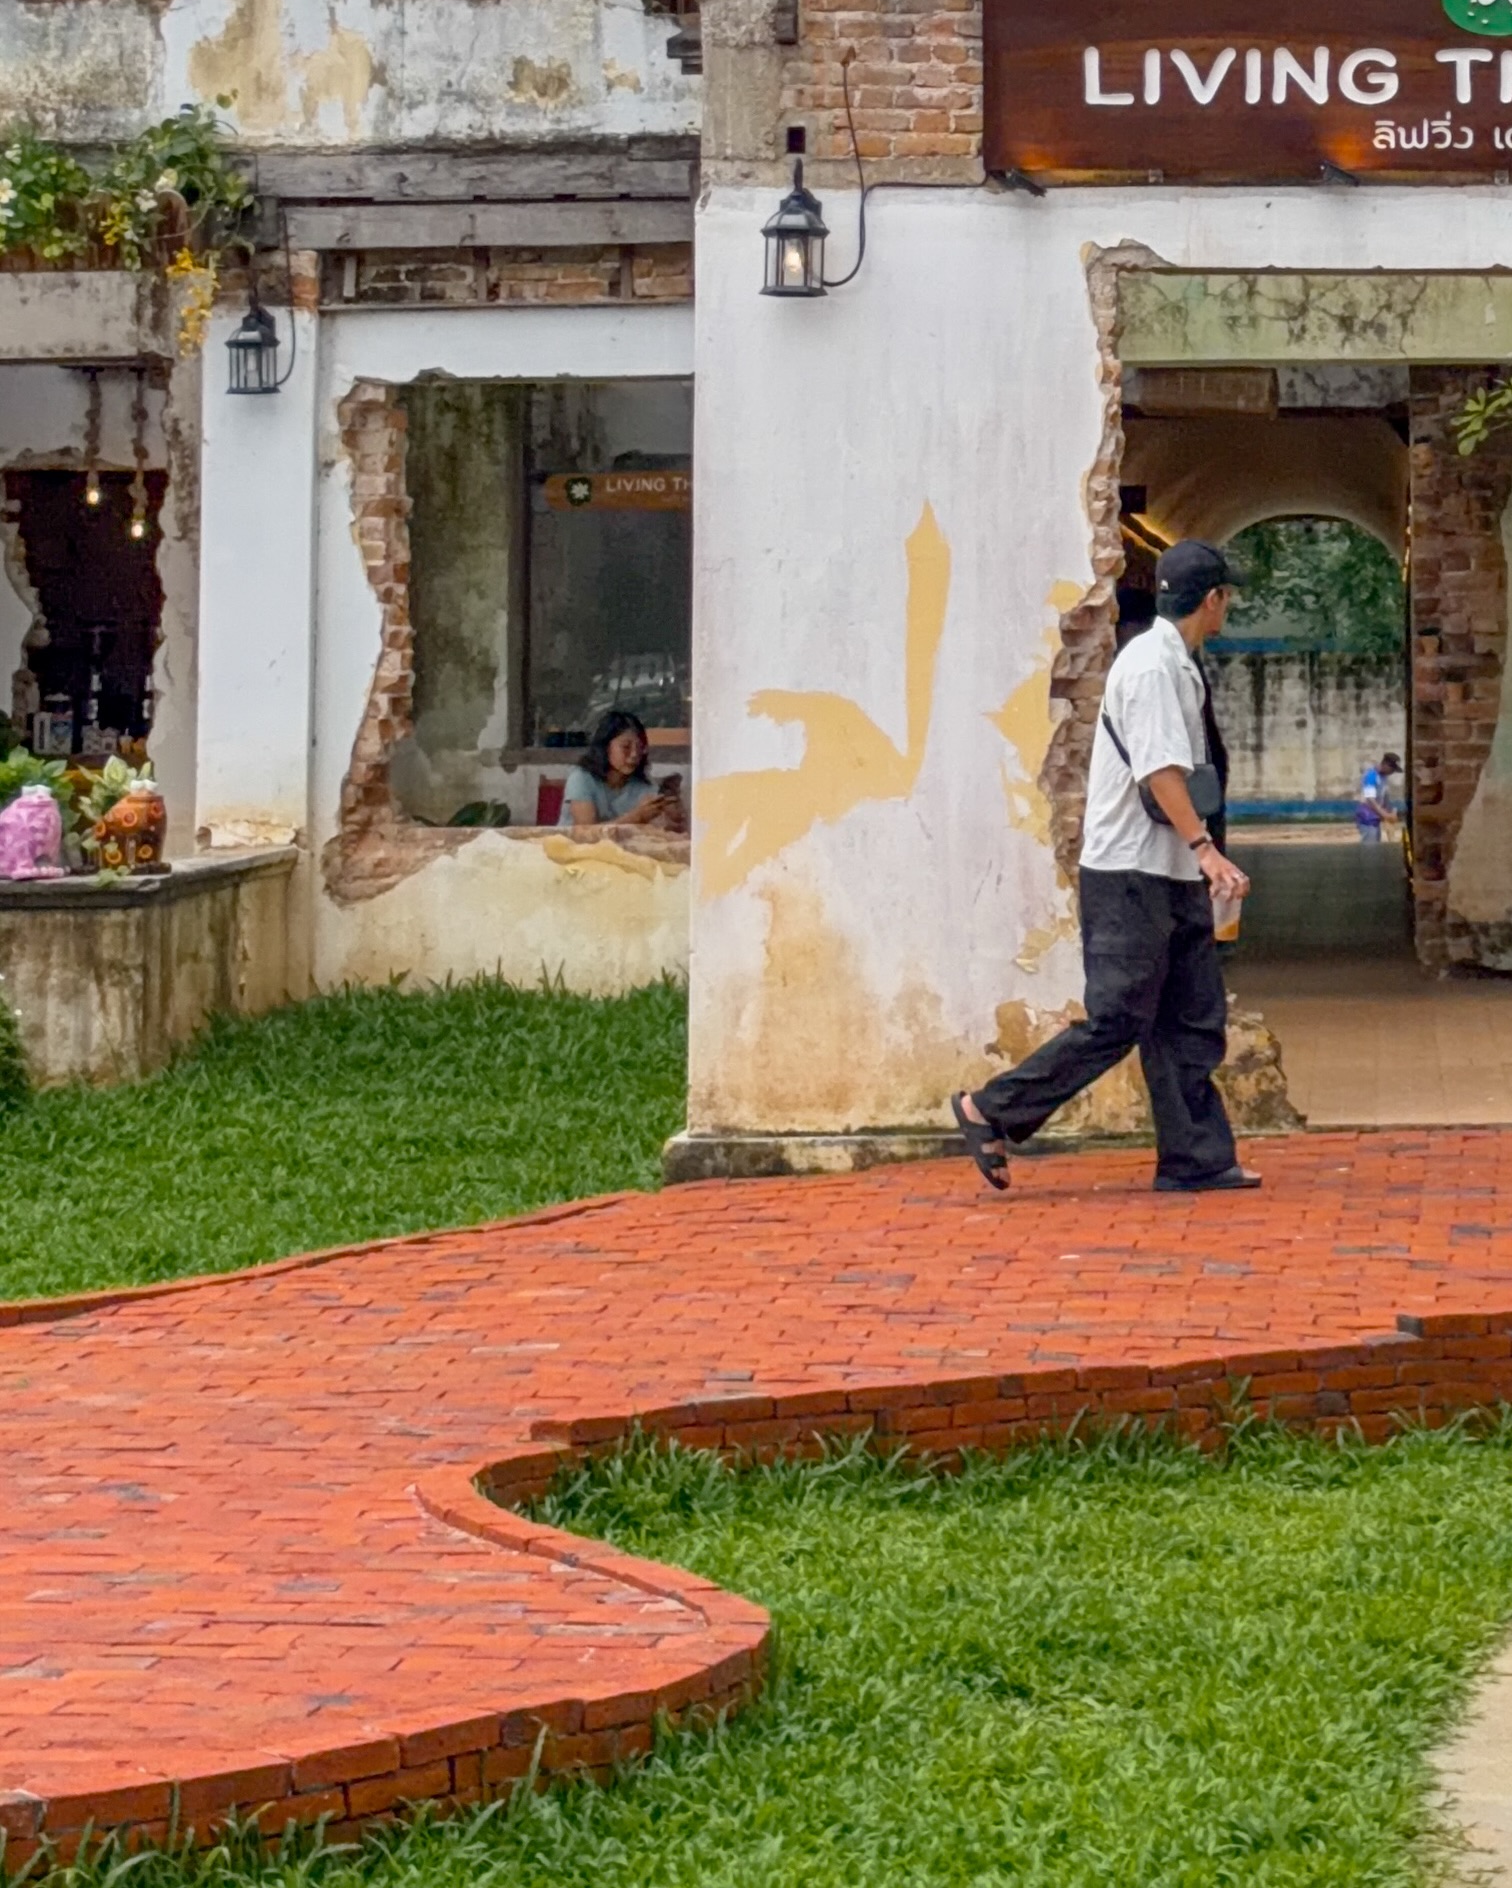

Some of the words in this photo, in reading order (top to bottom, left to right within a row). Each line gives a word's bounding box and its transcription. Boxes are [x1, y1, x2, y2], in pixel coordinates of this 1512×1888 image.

[1083, 45, 1400, 105] LIVING
[1372, 110, 1474, 150] ลิฟวิ่ง
[606, 477, 666, 492] LIVING
